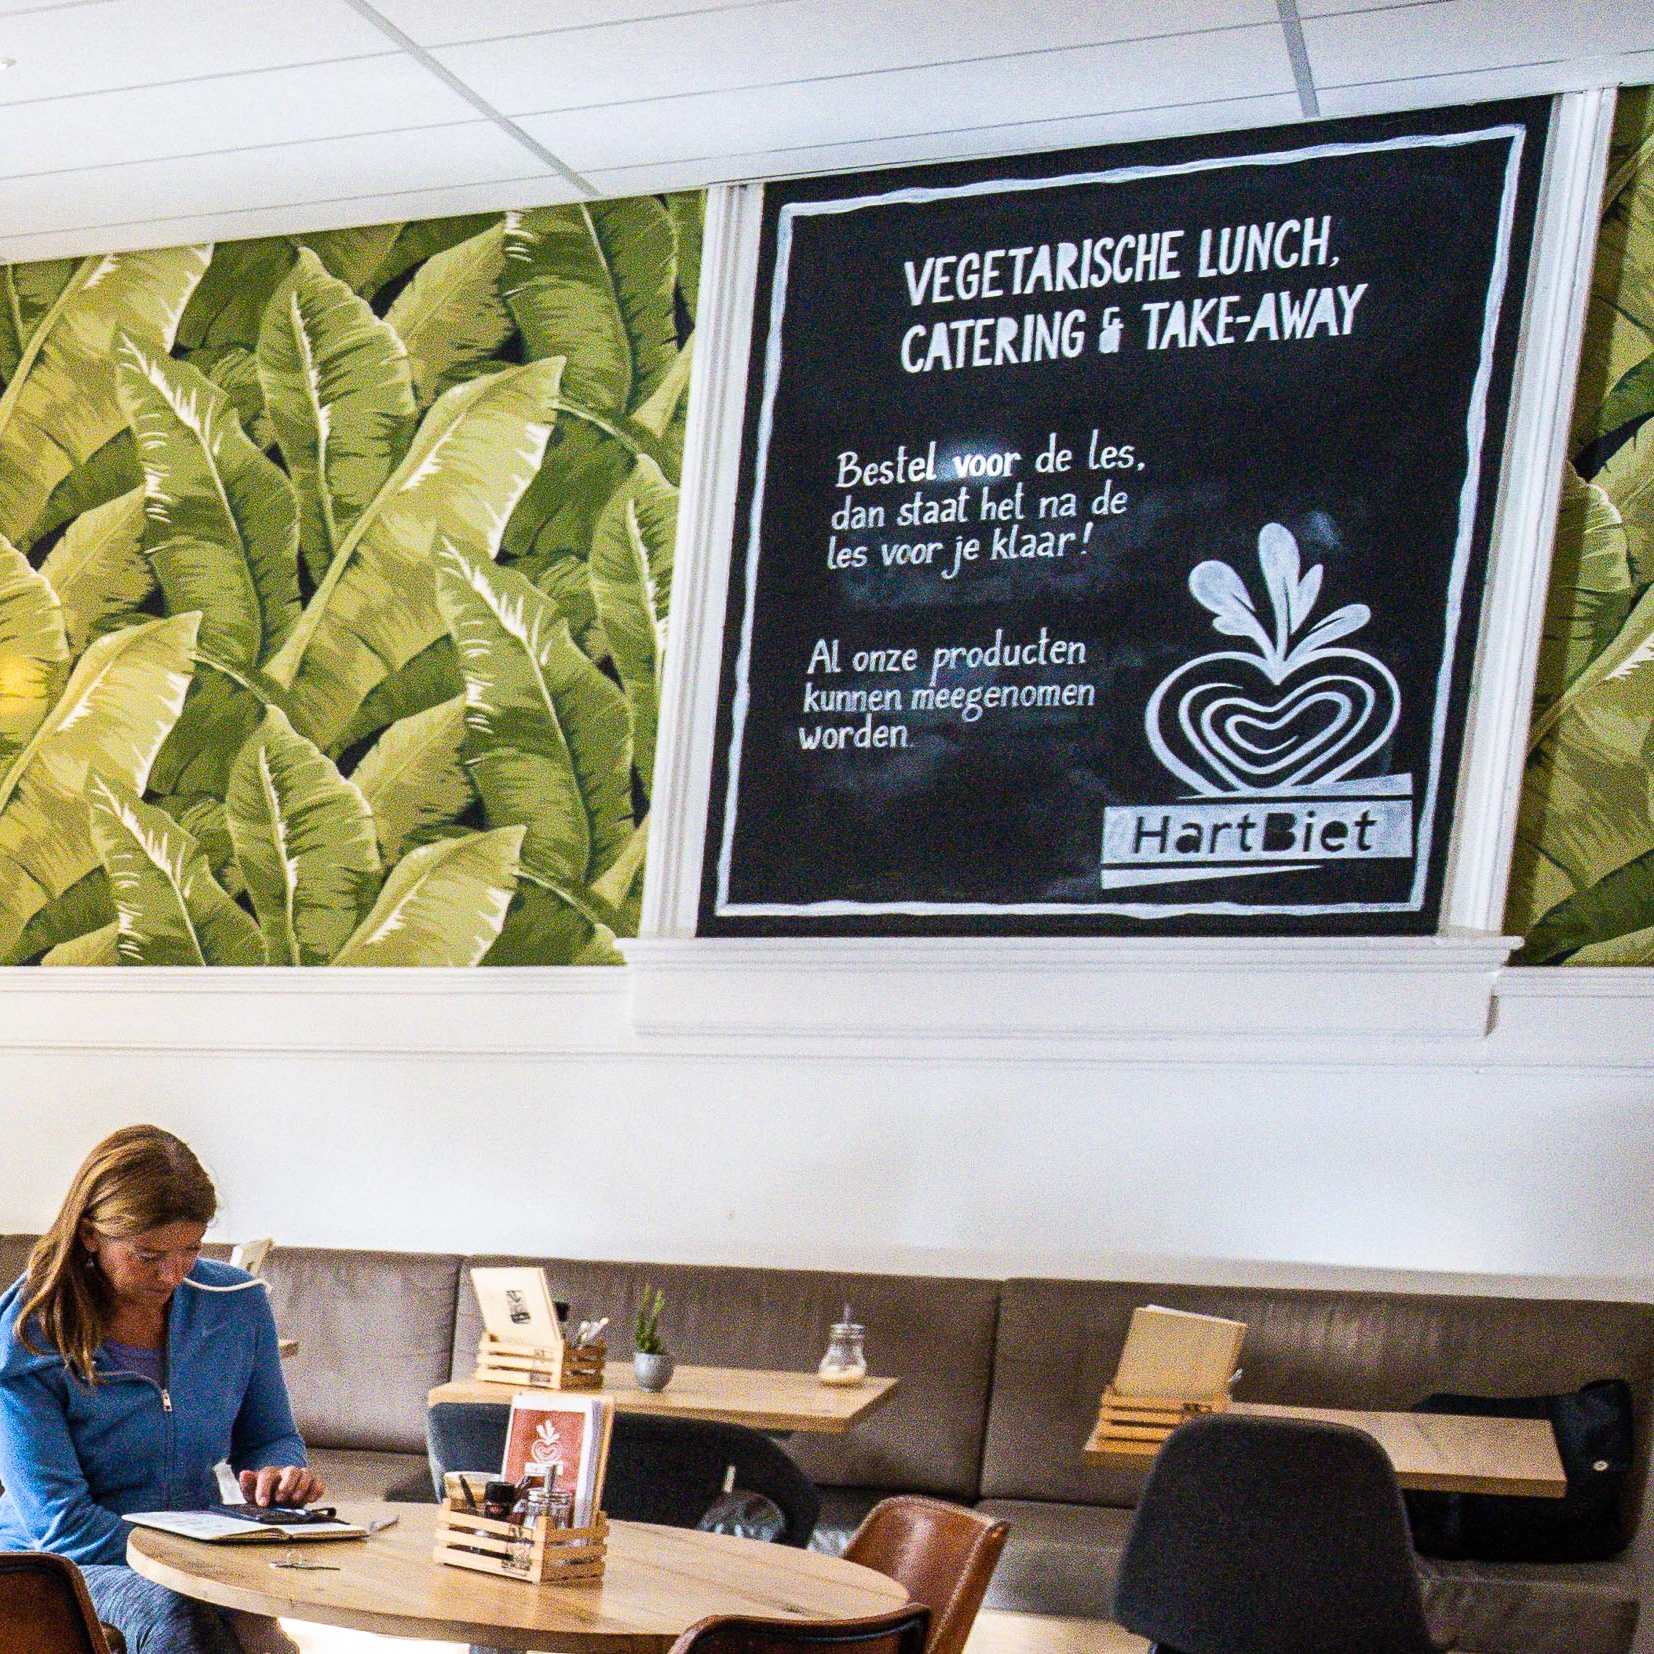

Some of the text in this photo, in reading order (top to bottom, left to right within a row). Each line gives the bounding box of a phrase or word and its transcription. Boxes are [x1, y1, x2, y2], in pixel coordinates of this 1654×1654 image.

[904, 215, 1339, 306] VEGETARISCHE LUNCH,
[900, 283, 1368, 373] CATERING & TAKE-AWAY
[835, 429, 1146, 488] Bestel voor de les,
[831, 479, 1128, 531] dan staat het na de
[827, 521, 1093, 580] les voor je klaar!
[807, 627, 1086, 687] Al onze producten
[803, 681, 1095, 722] kunnen meegenomen
[1131, 807, 1377, 855] HartBiet
